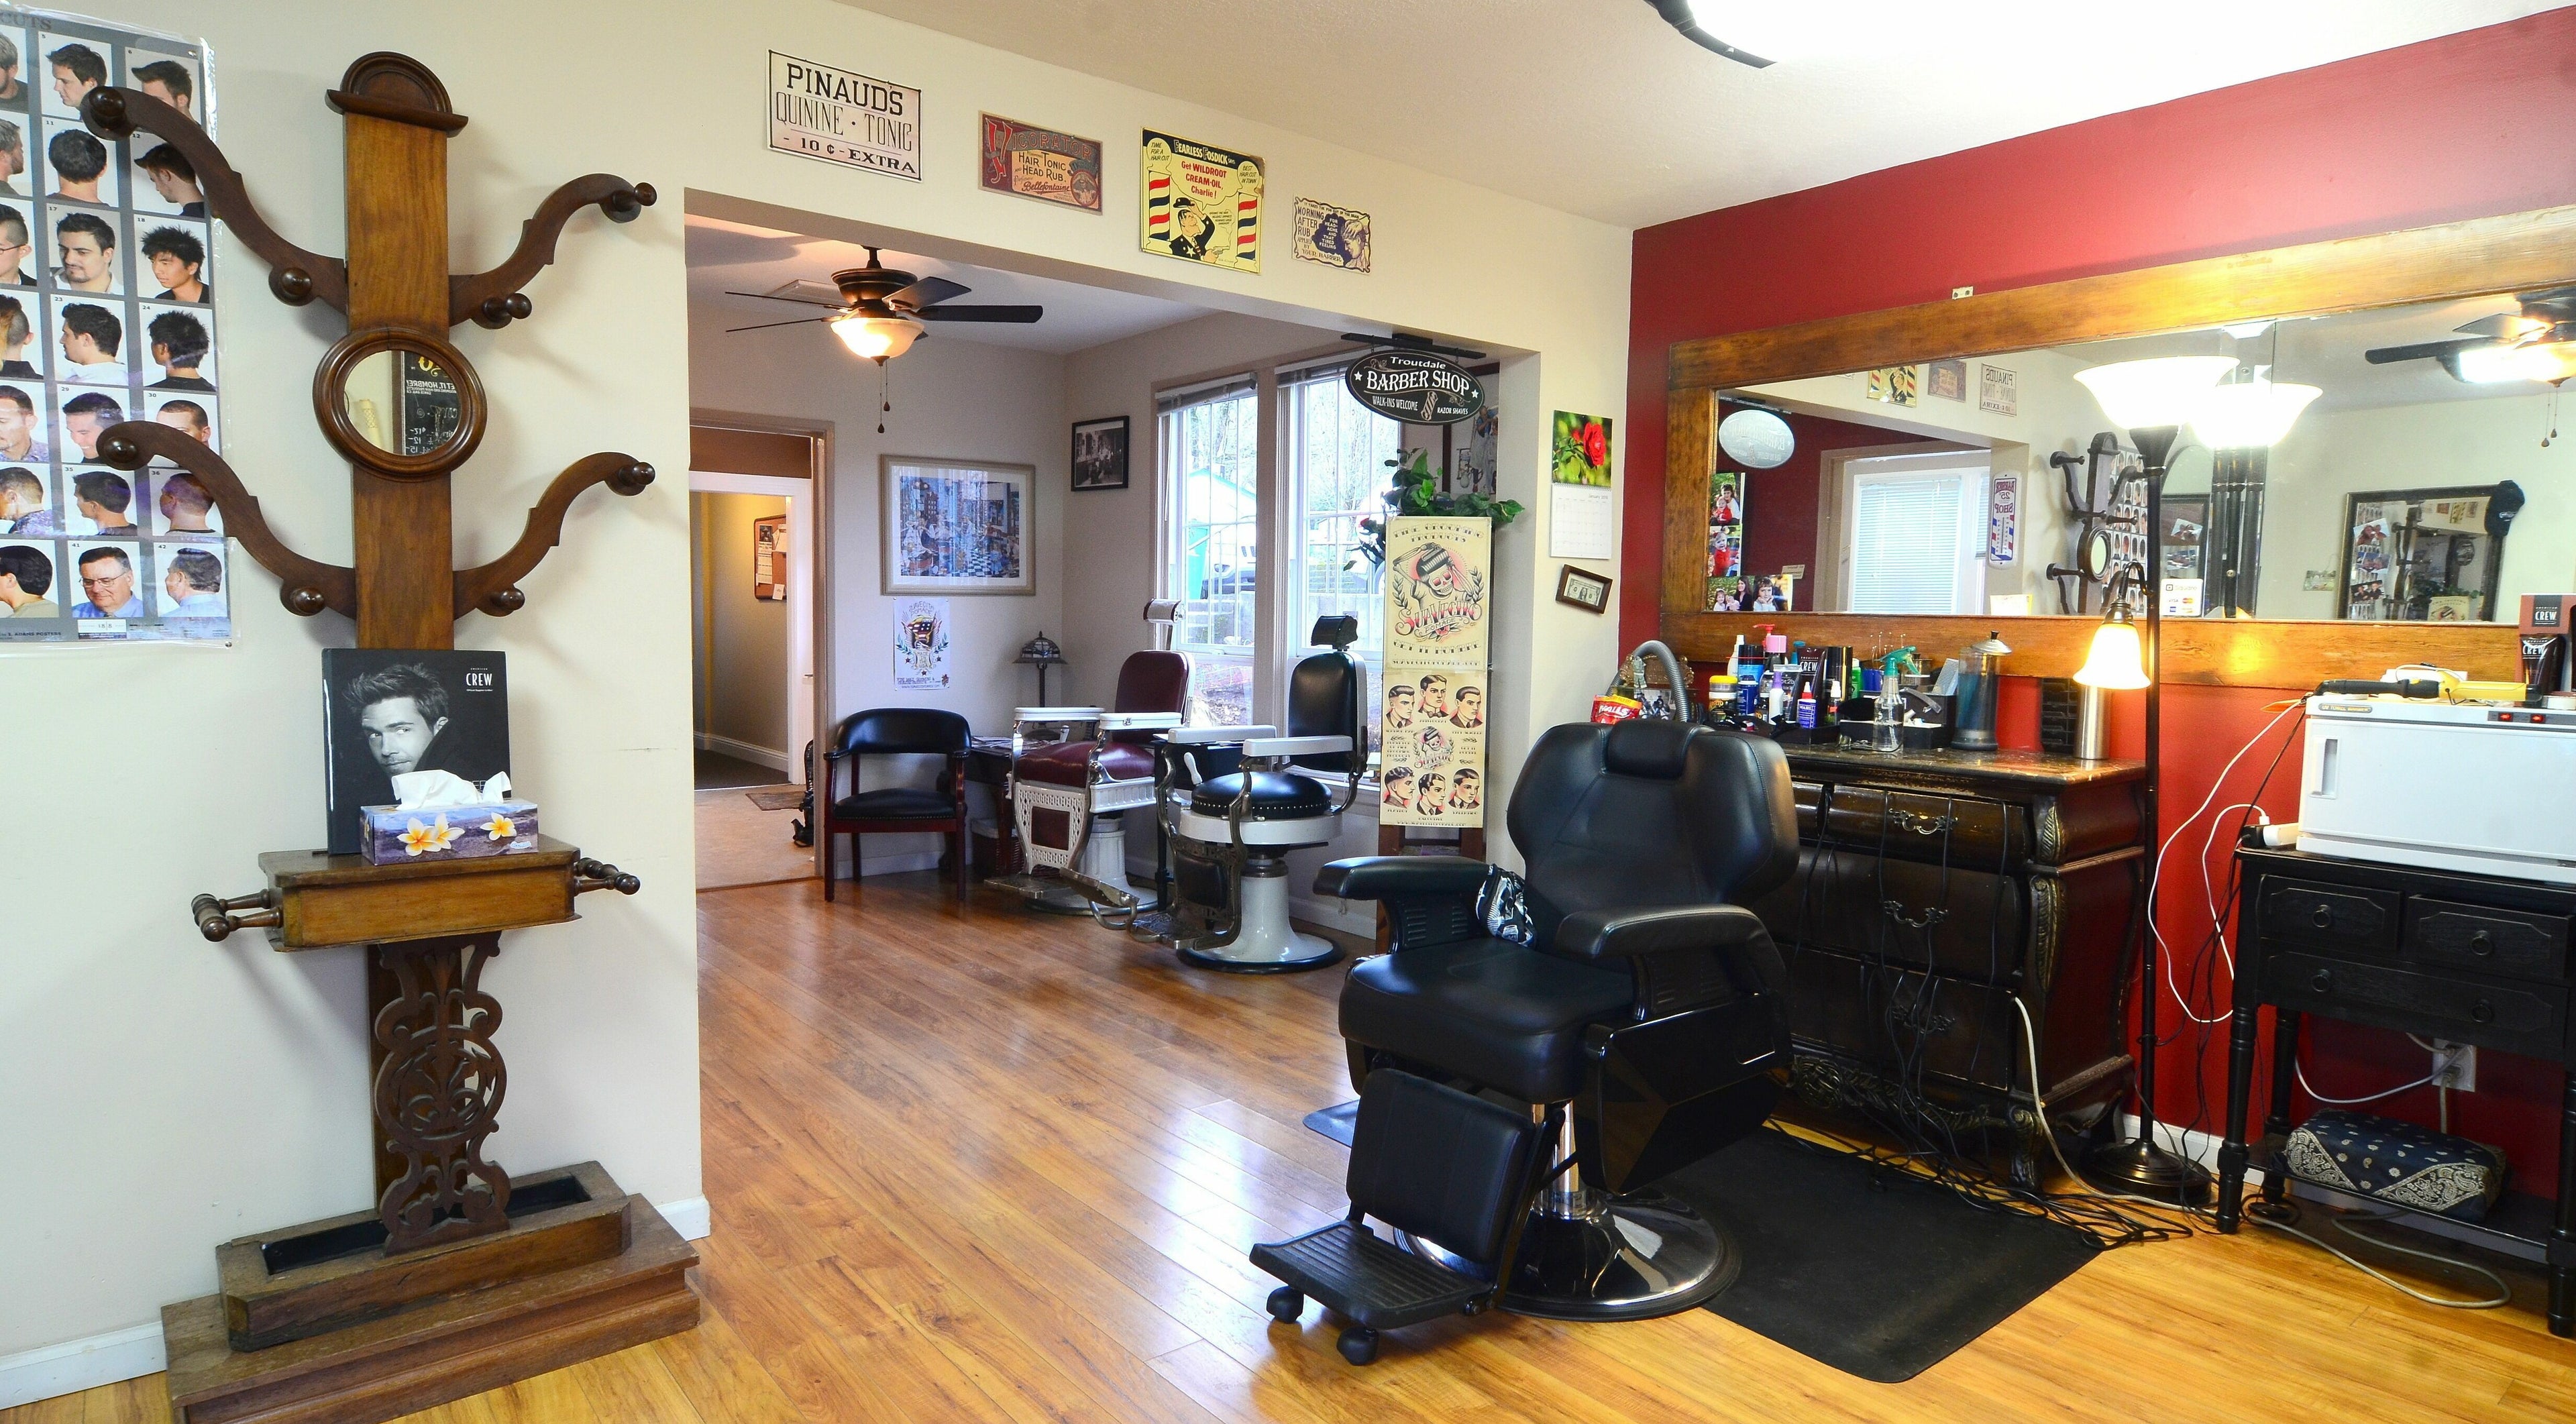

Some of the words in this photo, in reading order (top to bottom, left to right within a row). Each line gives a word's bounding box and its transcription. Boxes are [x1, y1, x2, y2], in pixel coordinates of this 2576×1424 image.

[787, 62, 903, 116] PINAUD'S
[776, 91, 844, 136] QUININE
[864, 113, 912, 152] TONIC
[1174, 140, 1203, 157] FEARLESS
[1203, 147, 1228, 165] FOSDICK
[848, 148, 916, 174] EXTRA
[1018, 152, 1040, 169] HAIR
[1041, 152, 1066, 171] TONIC
[1022, 165, 1044, 177] HEAD
[1181, 161, 1191, 170] Get
[1193, 163, 1227, 178] WILDROOT
[1297, 206, 1324, 220] MORNING
[1297, 216, 1318, 229] AFTER
[1298, 226, 1311, 237] RUB
[1390, 356, 1446, 369] Troutdale
[1366, 370, 1429, 392] BARBER
[1432, 370, 1470, 396] SHOP
[1373, 396, 1395, 408] WALK-INS
[1395, 398, 1418, 411] WELCOME
[2535, 611, 2557, 620] CREW
[1425, 618, 1455, 633] POMADE
[1800, 661, 1818, 671] CREW
[466, 673, 492, 686] CREW
[1599, 704, 1629, 716] HALLS
